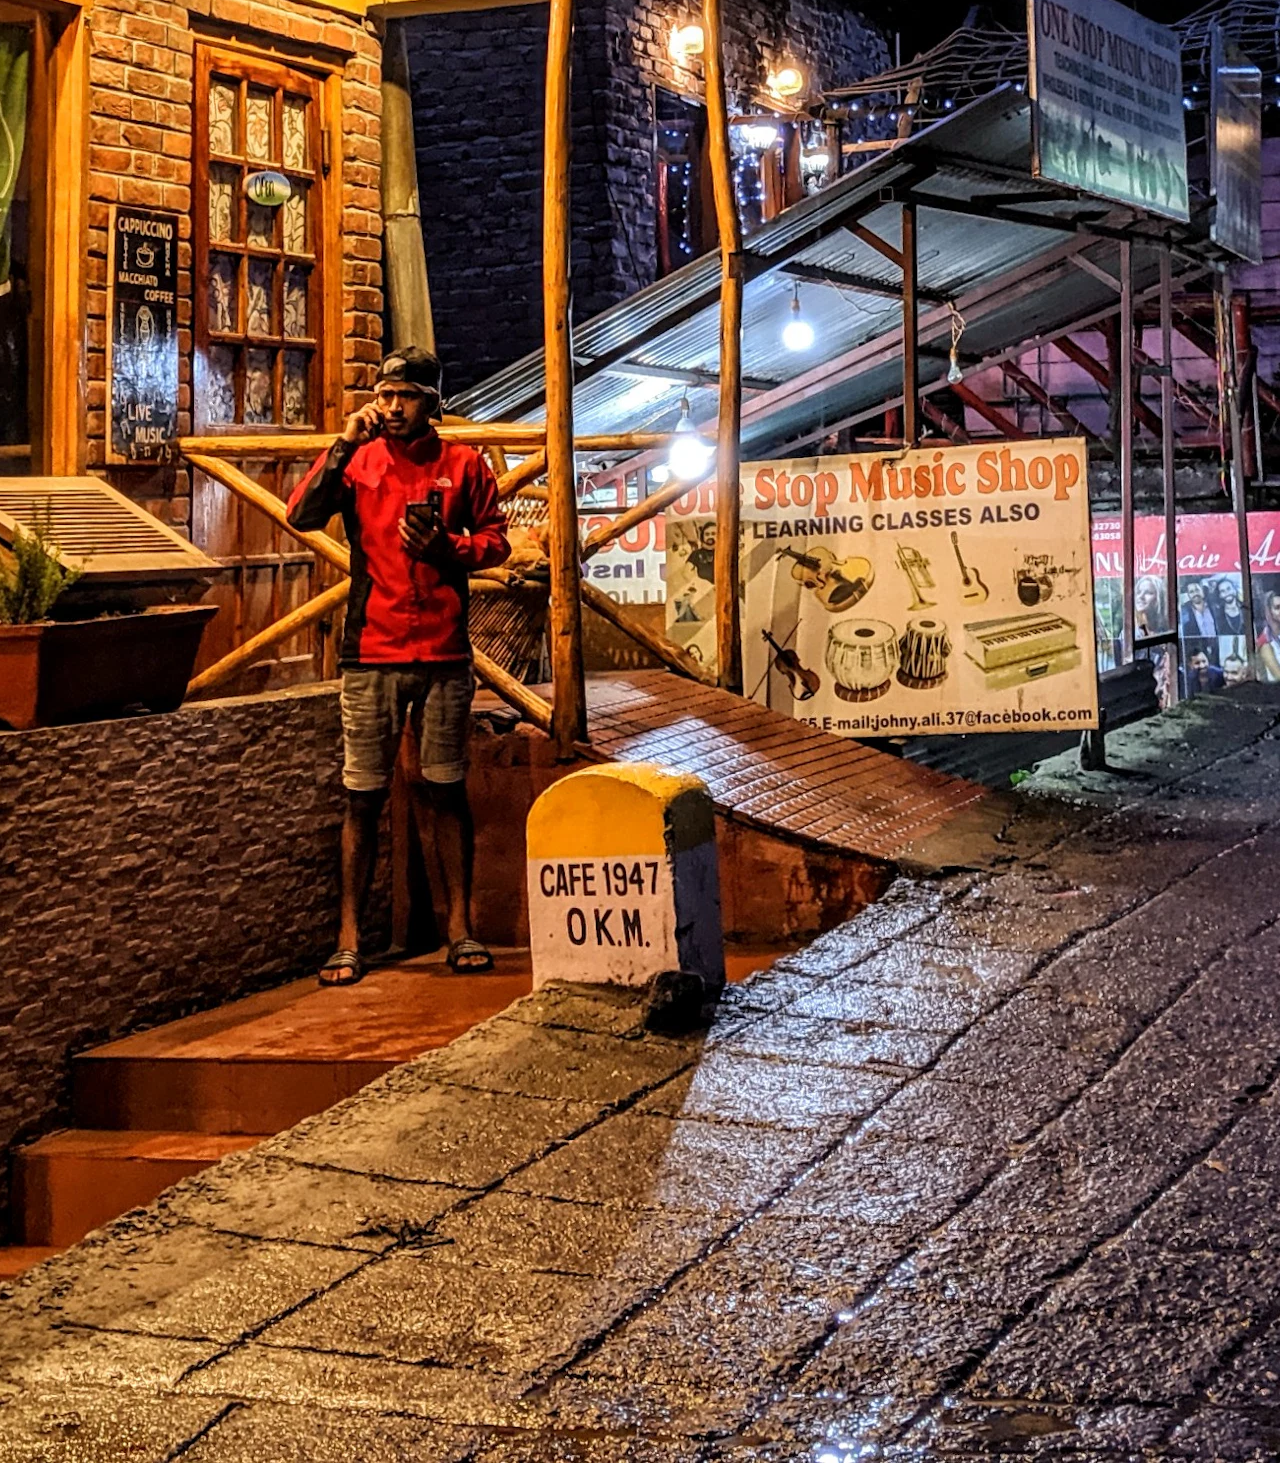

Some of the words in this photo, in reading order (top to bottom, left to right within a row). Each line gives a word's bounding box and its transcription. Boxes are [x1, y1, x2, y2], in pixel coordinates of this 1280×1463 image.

[1073, 12, 1106, 63] STOP
[1107, 31, 1146, 83] MUSIC
[1147, 50, 1178, 96] SHOP
[117, 216, 173, 241] CAPPUCCINO
[118, 270, 159, 287] MACCHIATO
[144, 289, 175, 305] COFFEE
[127, 403, 153, 422] LIVE
[135, 426, 167, 444] MUSIC
[754, 467, 836, 517] Stop
[849, 451, 966, 503] Music
[976, 448, 1080, 501] Shop
[752, 515, 863, 539] LEARNING
[871, 508, 972, 532] CLASSES
[979, 502, 1041, 525] ALSO
[540, 863, 597, 898] CAFE
[602, 861, 659, 897] 1947
